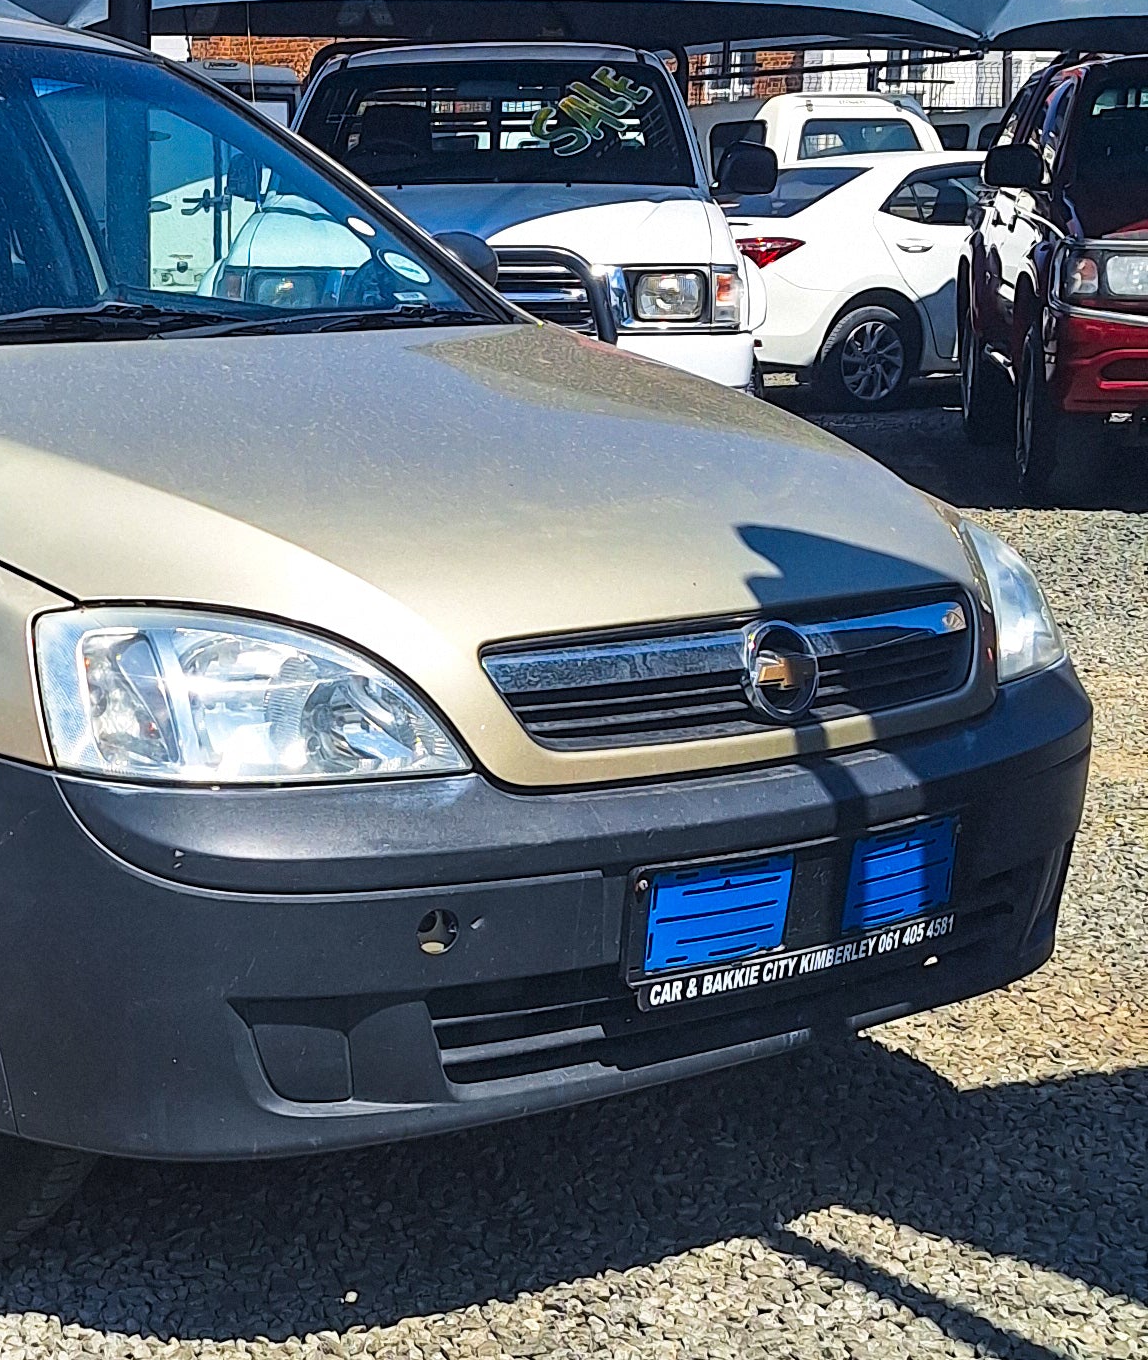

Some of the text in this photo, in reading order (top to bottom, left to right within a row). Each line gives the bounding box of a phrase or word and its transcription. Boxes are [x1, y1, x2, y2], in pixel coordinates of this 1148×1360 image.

[530, 65, 654, 157] SALE
[649, 913, 955, 1006] CAR & BAKKIE CITY KIMBERLEY 061 405 4581
